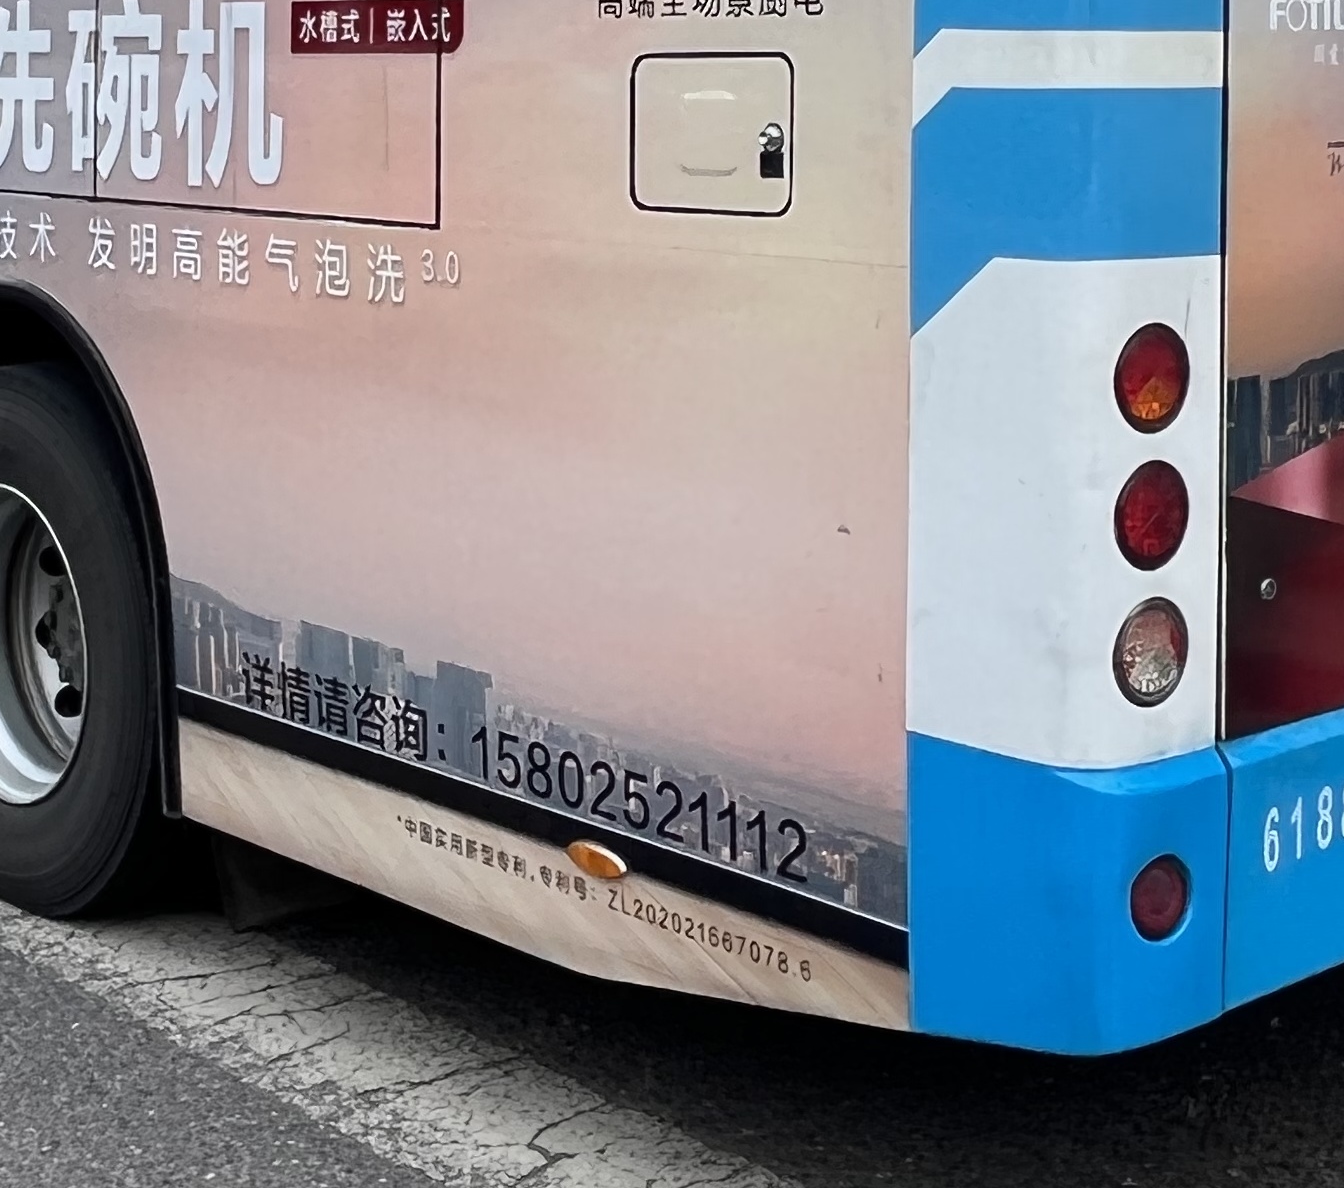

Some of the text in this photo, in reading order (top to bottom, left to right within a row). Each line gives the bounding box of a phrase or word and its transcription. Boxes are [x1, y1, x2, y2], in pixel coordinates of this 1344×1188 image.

[299, 6, 451, 44] 水槽式 嵌入式
[87, 216, 406, 304] 发明高能气泡洗
[420, 248, 460, 286] 3.0
[471, 726, 808, 883] 15802521112
